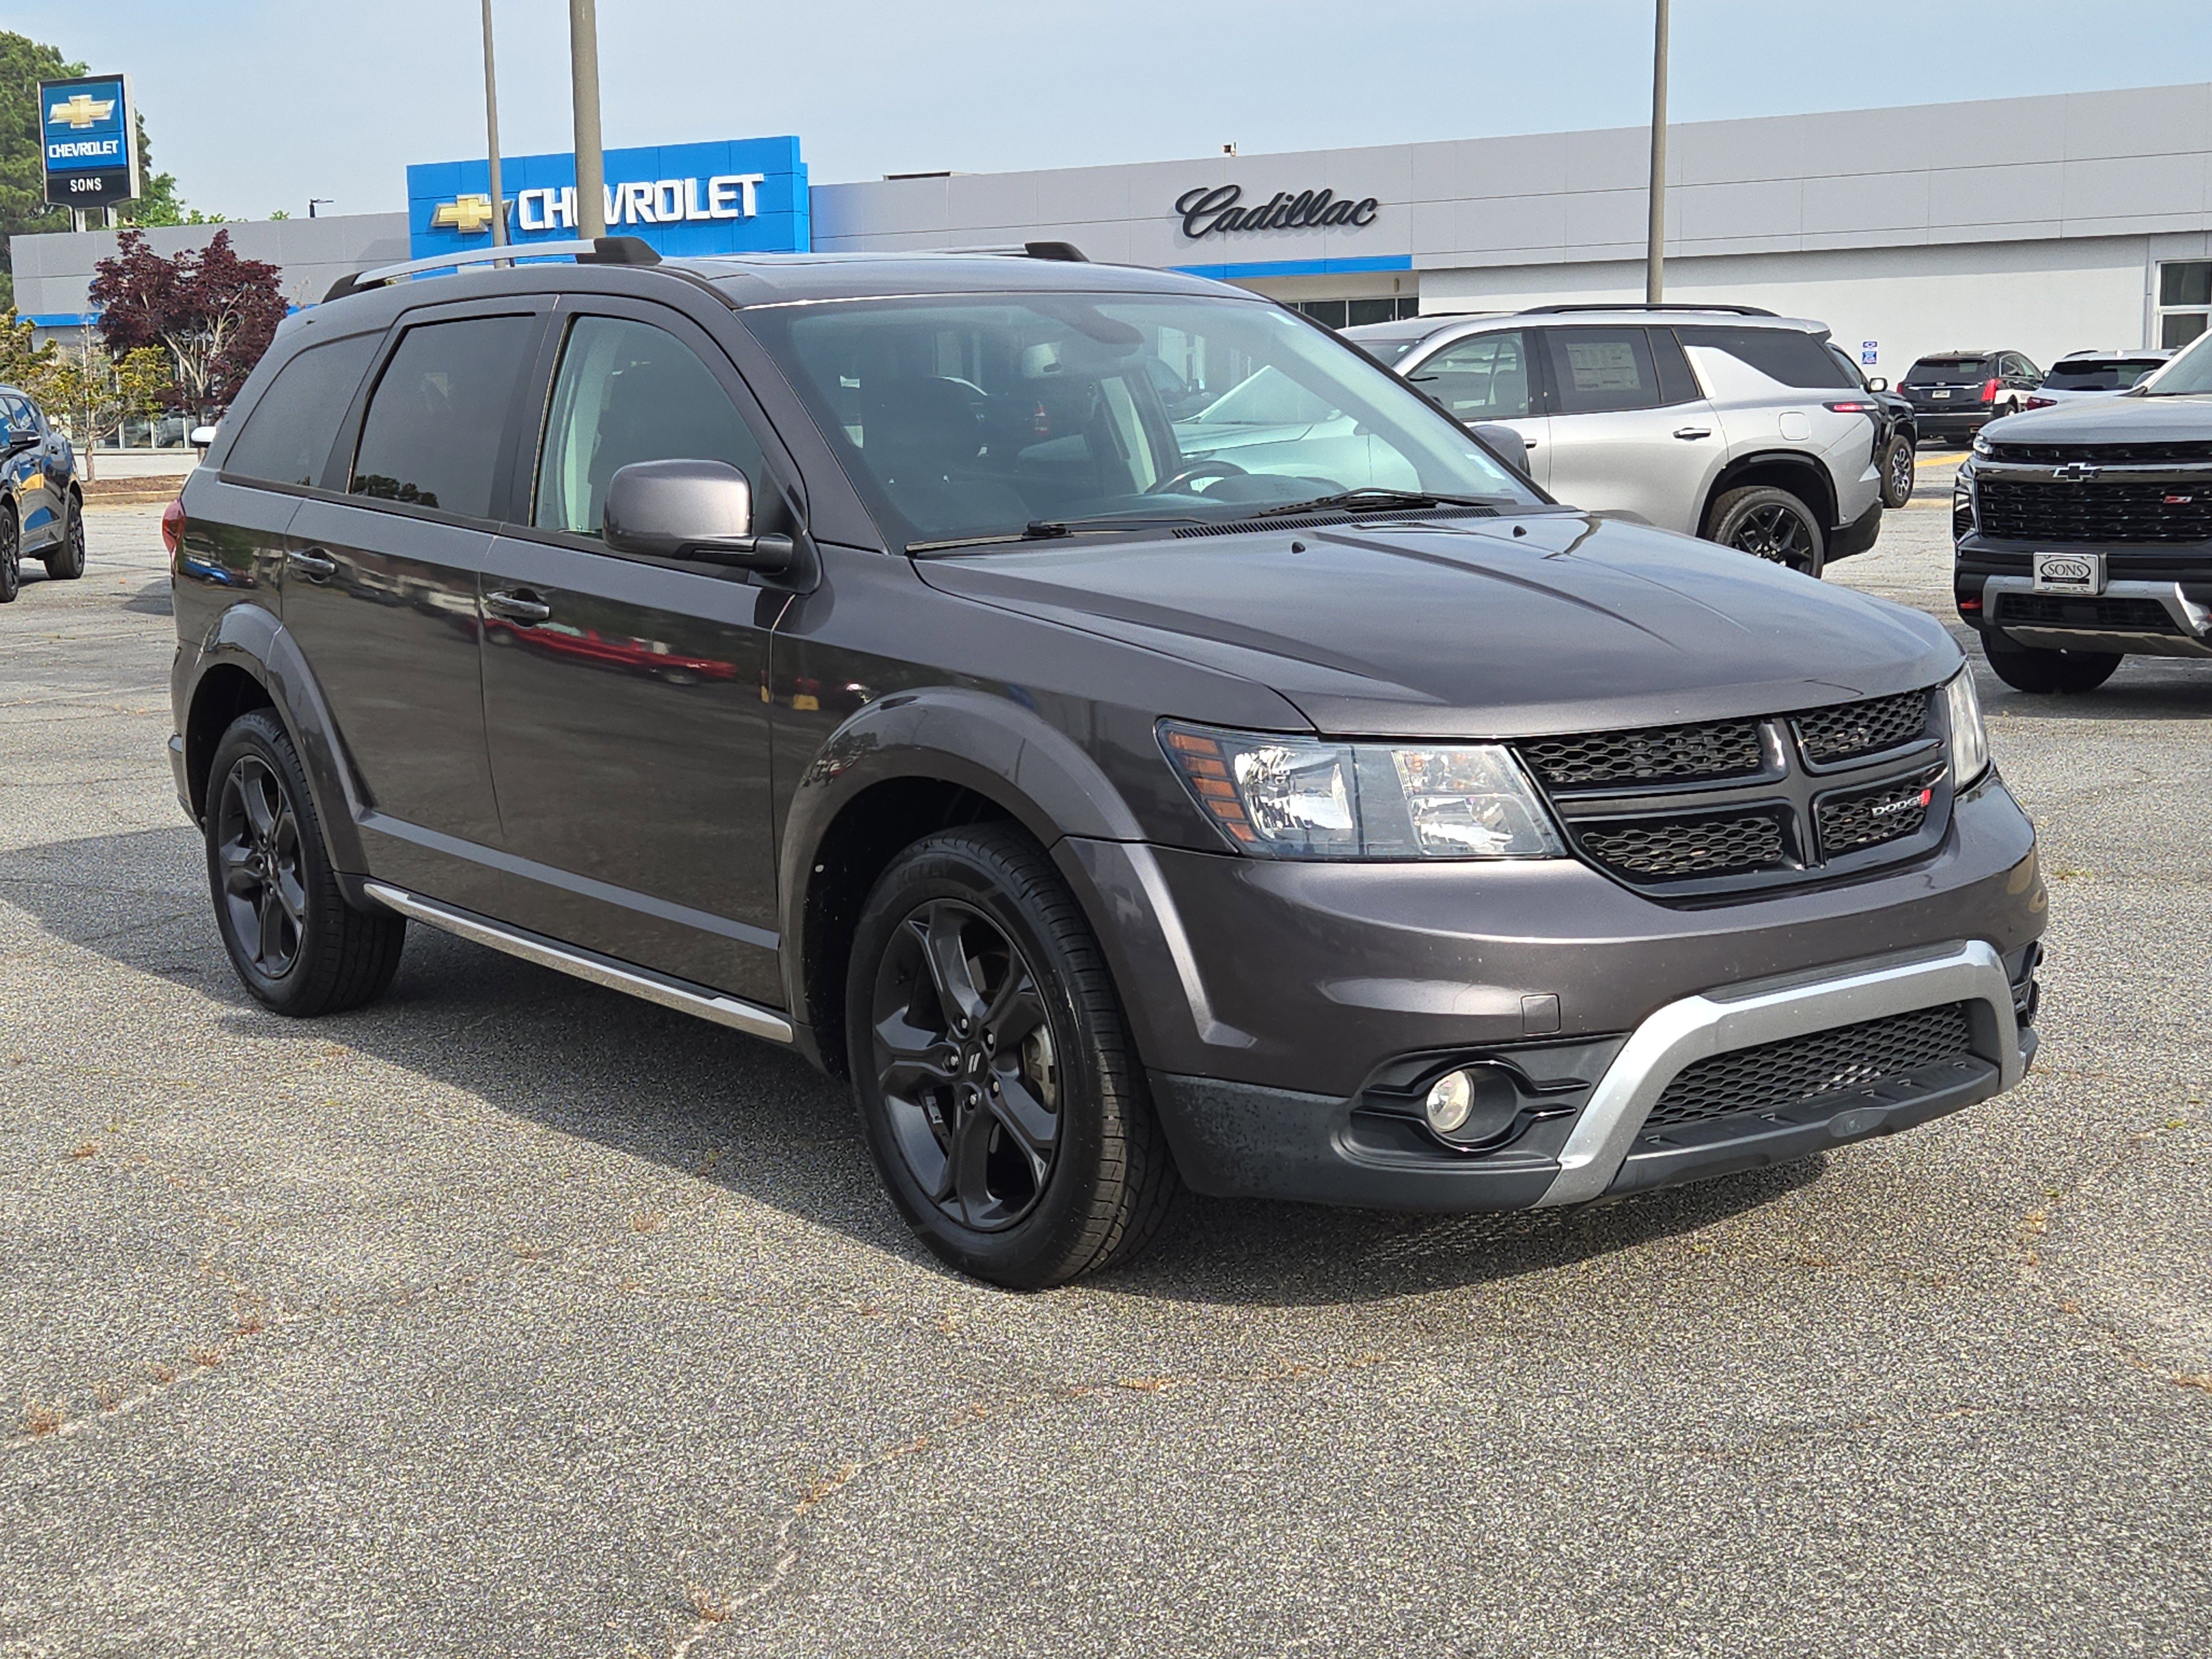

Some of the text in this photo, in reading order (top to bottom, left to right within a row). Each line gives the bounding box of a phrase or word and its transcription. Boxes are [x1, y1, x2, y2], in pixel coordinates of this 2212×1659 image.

[49, 140, 119, 158] CHEVROLET
[70, 177, 102, 192] SONS
[518, 173, 764, 230] CHVROLET
[1175, 184, 1378, 239] Cadillac
[2047, 564, 2084, 577] SONS
[1872, 795, 1923, 815] DODGE
